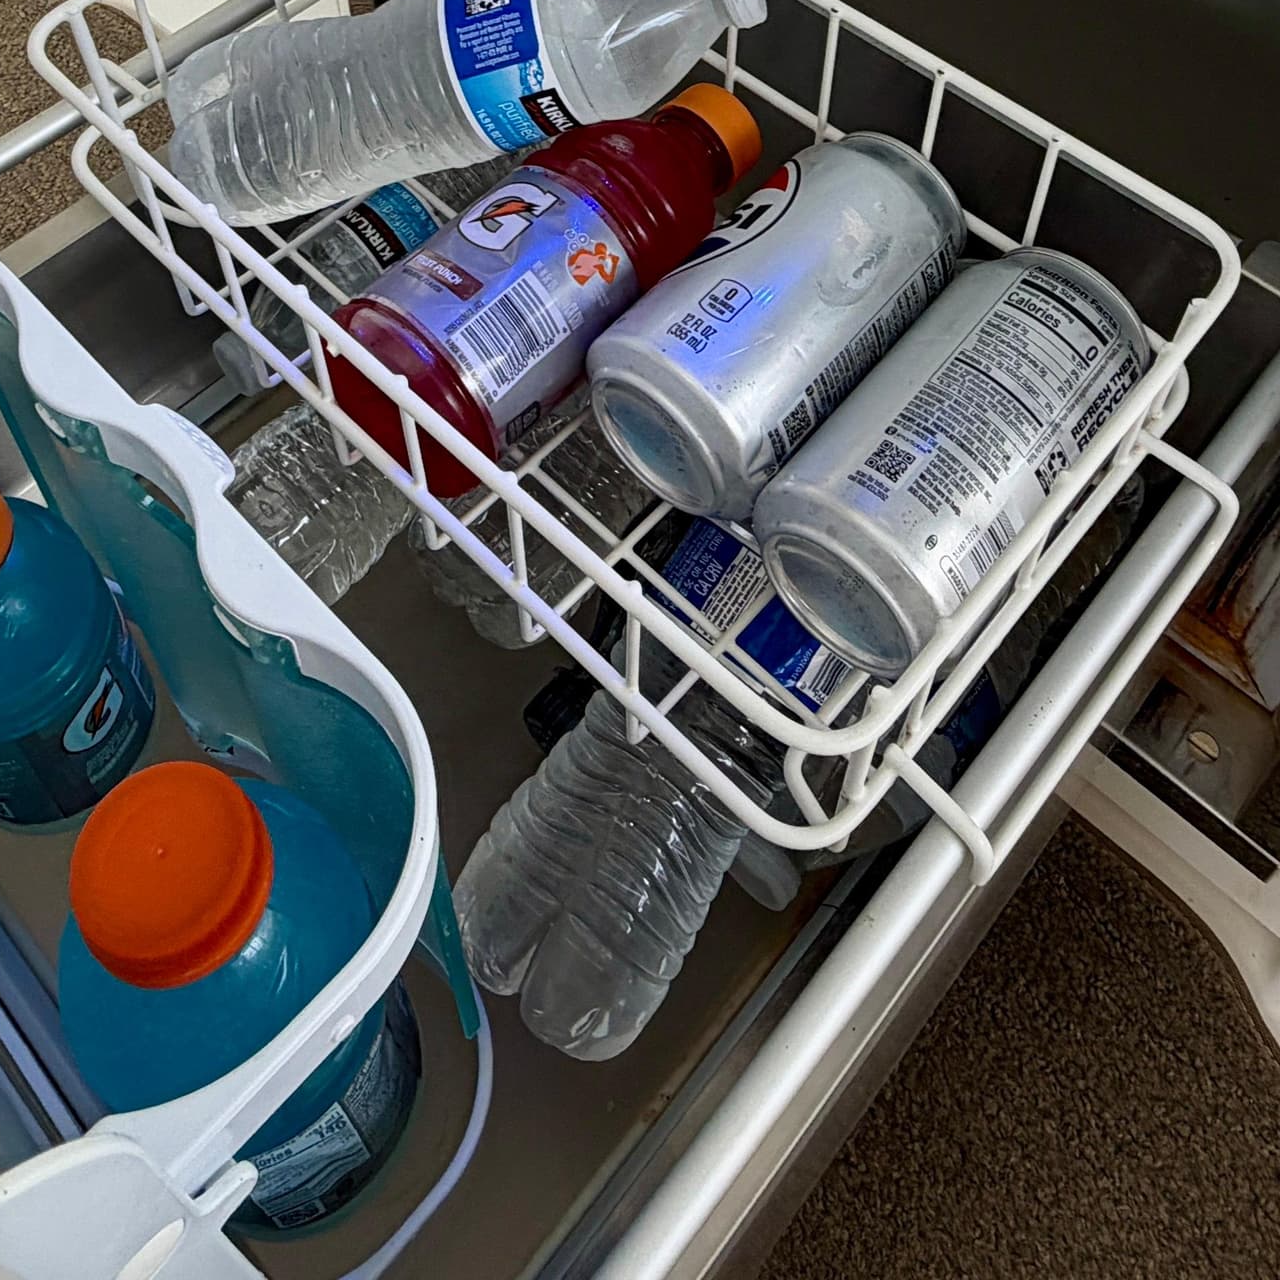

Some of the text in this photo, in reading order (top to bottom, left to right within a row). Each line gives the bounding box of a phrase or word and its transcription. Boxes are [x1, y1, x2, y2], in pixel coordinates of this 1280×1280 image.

[497, 96, 540, 144] purified
[535, 91, 574, 135] KIRKL
[343, 207, 395, 261] KIRKLAN
[432, 261, 463, 287] PUNCH
[723, 285, 740, 302] 0
[1025, 268, 1061, 293] Serving
[1057, 286, 1077, 303] Size
[1099, 322, 1115, 340] can
[1032, 263, 1122, 330] Nutrition Facts
[664, 319, 709, 356] (355 mL)
[680, 311, 719, 342] 12 FL OZ
[1006, 288, 1063, 329] Calories
[1083, 343, 1101, 363] 0
[1067, 383, 1115, 440] REFRESH
[1108, 353, 1136, 388] THEN
[692, 576, 712, 598] CA
[701, 556, 725, 584] CRV
[254, 1146, 293, 1169] ories
